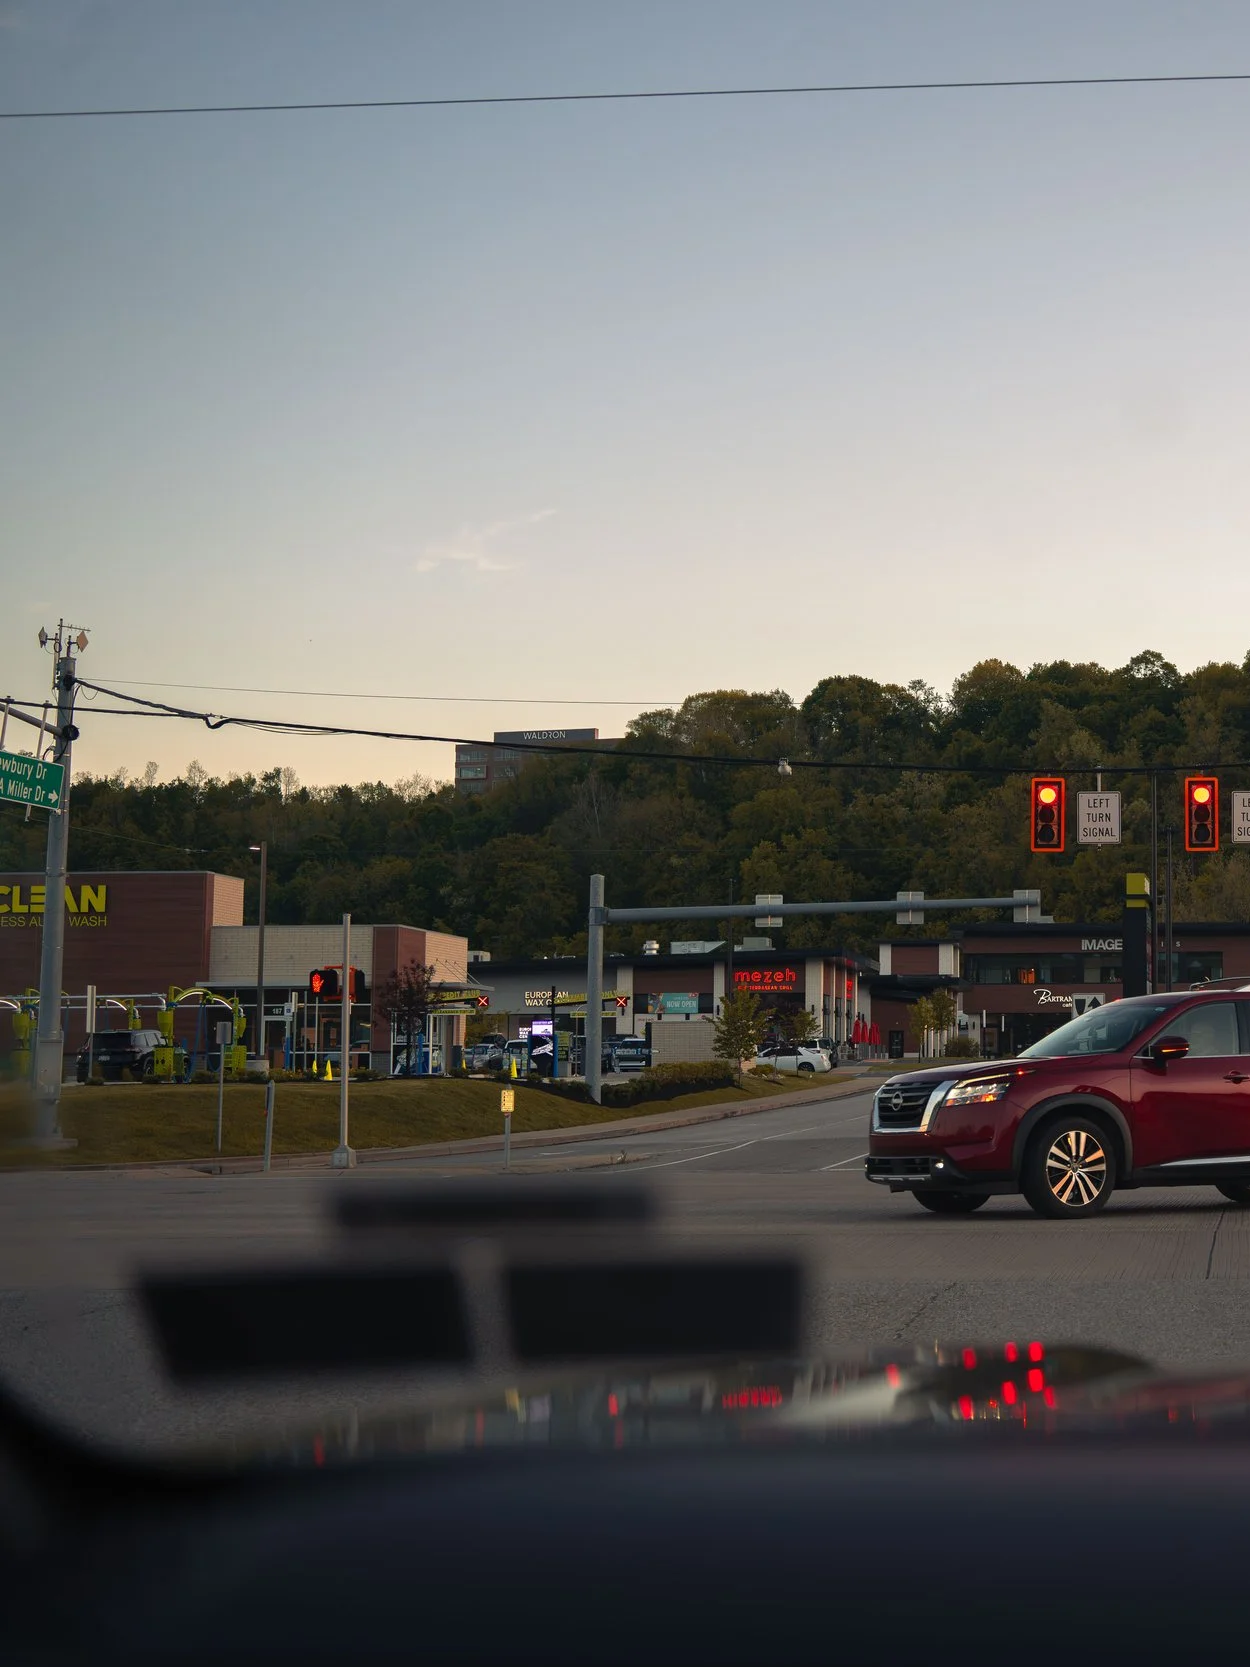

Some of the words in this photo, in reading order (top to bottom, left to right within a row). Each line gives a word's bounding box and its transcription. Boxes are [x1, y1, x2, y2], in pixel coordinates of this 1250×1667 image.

[523, 731, 566, 740] WALDRON
[0, 757, 33, 780] wbury
[36, 763, 48, 780] Dr
[7, 779, 33, 799] Miller
[34, 785, 46, 802] Dr
[1087, 798, 1110, 808] LEFT
[1086, 813, 1111, 823] TURN
[1083, 827, 1116, 837] SIGNAL
[69, 915, 107, 927] WASH
[1081, 939, 1123, 951] IMAGE
[734, 967, 797, 983] mezeh
[525, 991, 569, 999] EUROPAN
[525, 999, 544, 1007] WAX
[666, 1000, 681, 1008] NOW
[681, 1000, 697, 1008] OPEN
